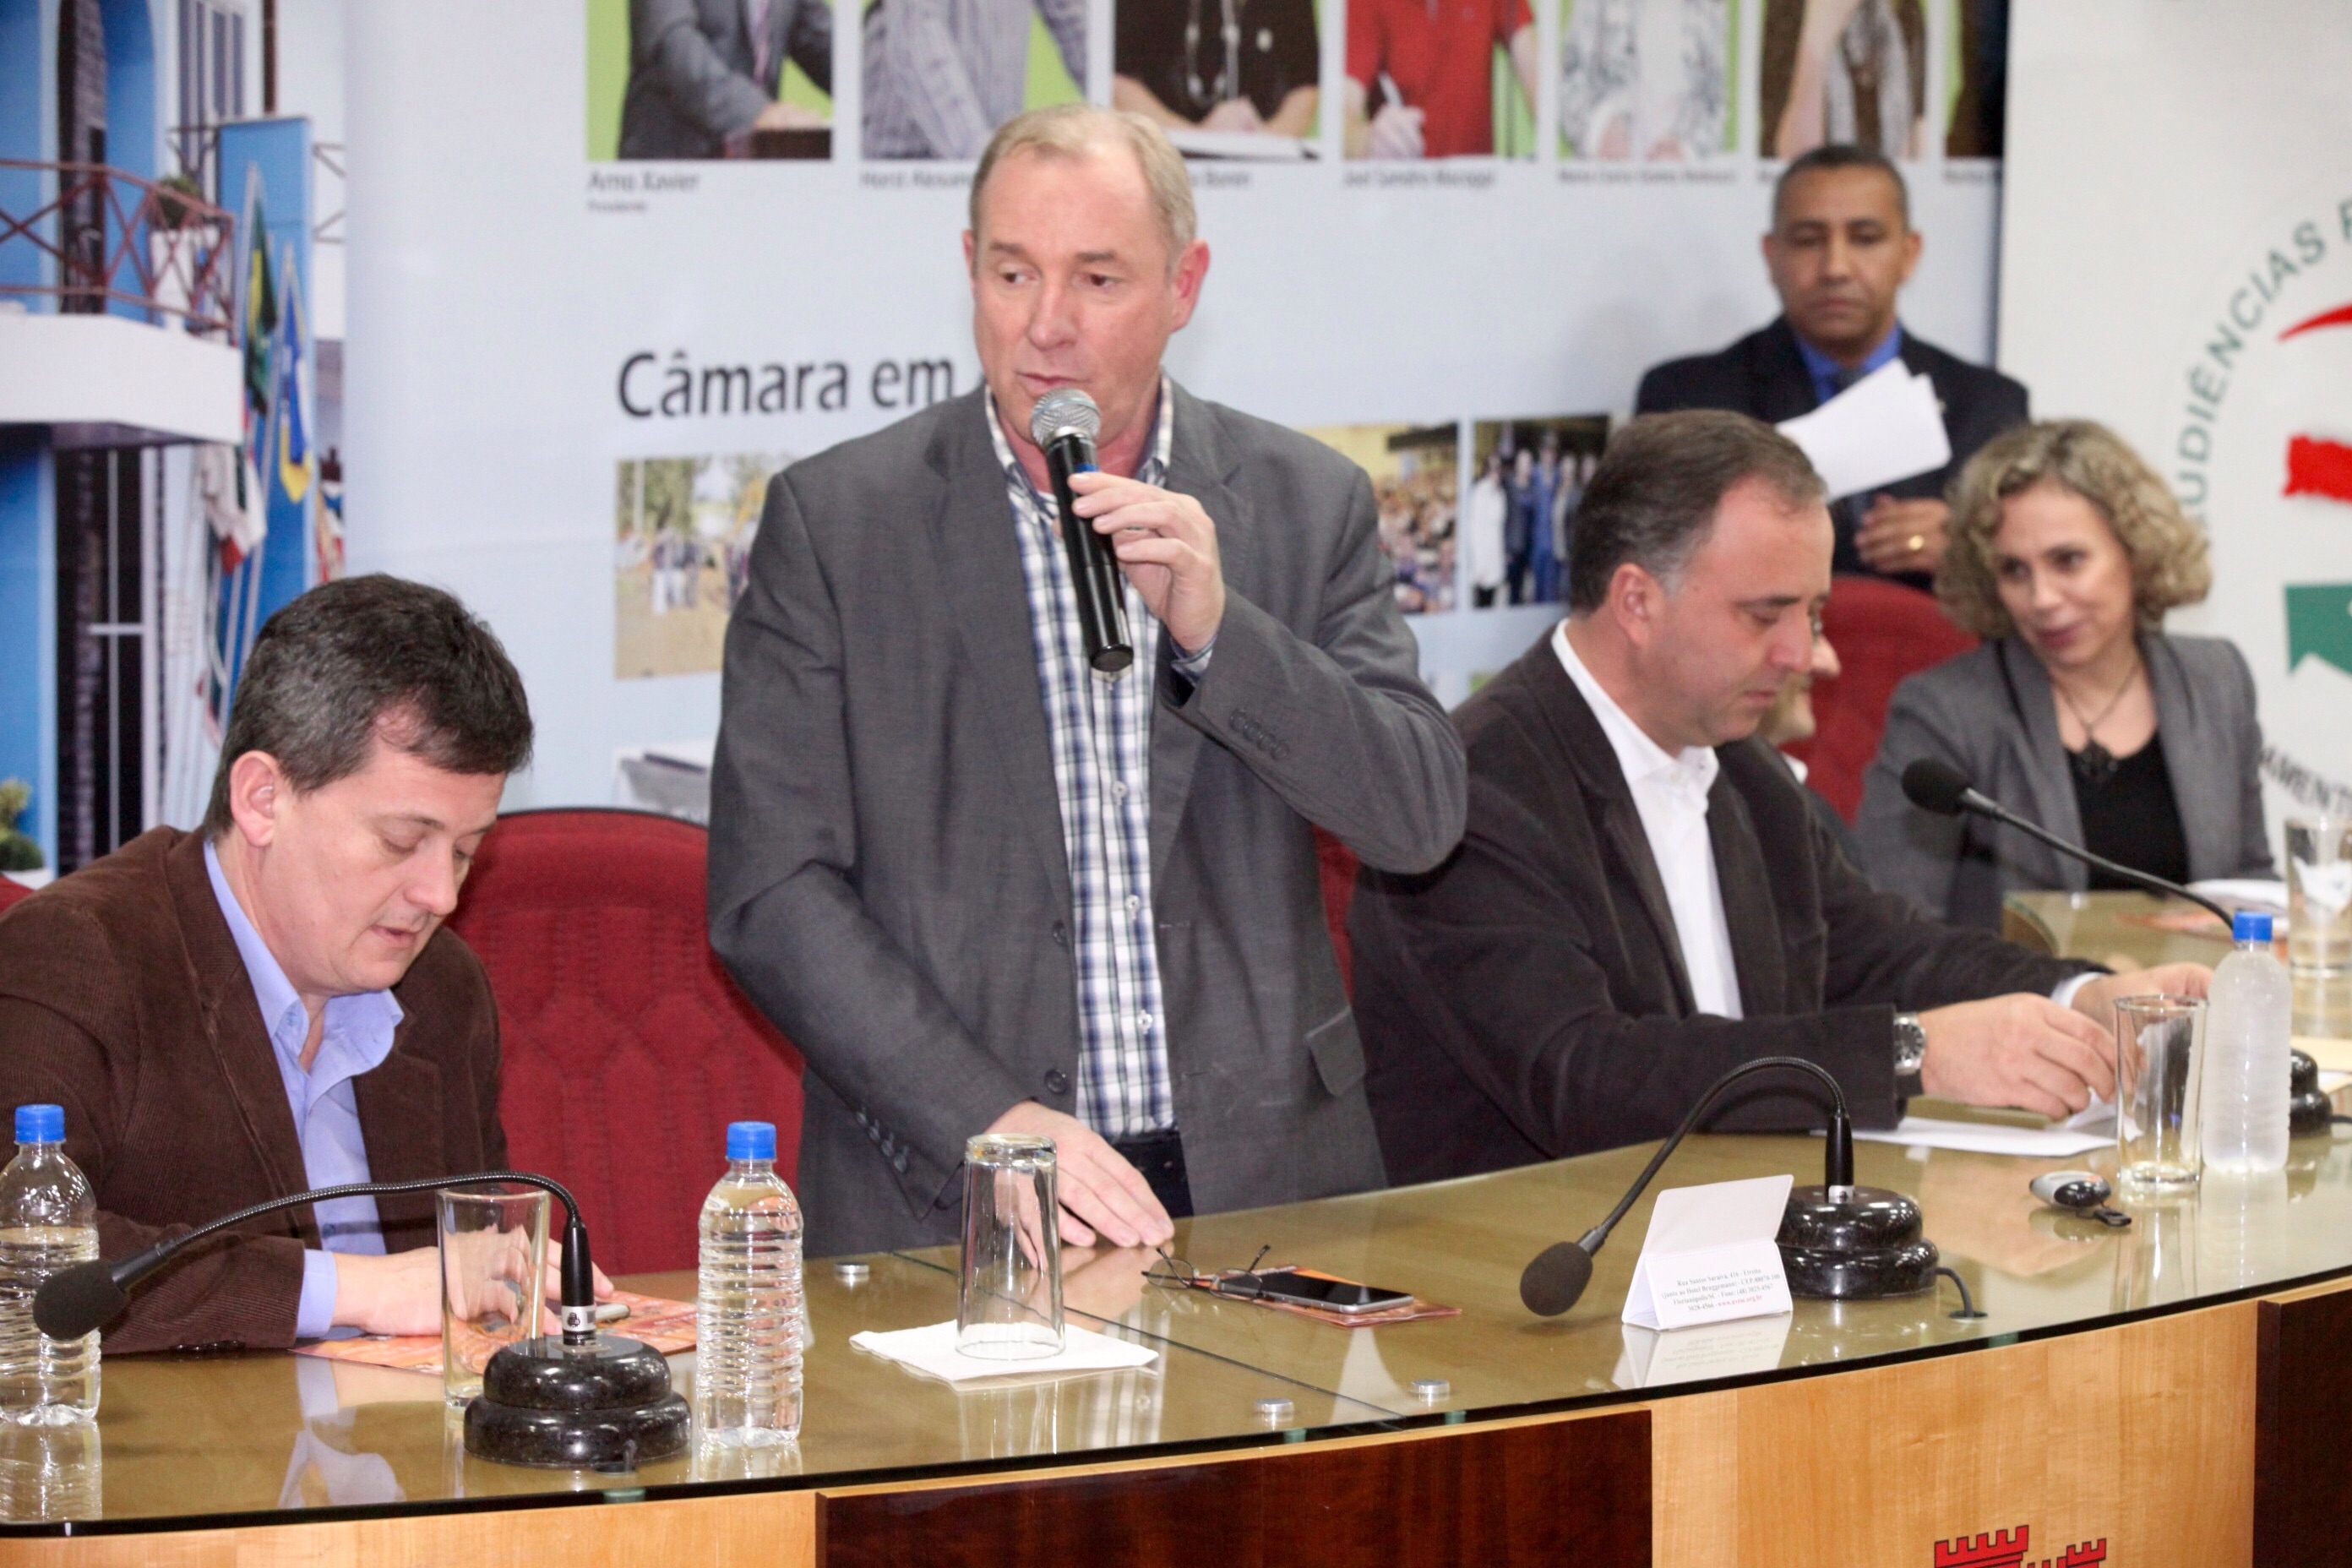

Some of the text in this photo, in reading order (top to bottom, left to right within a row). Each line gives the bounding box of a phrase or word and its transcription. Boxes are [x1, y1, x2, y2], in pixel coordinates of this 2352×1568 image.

[587, 169, 635, 188] Arno
[618, 349, 956, 418] Câmara em
[2175, 219, 2328, 512] UDIÊNCIAS
